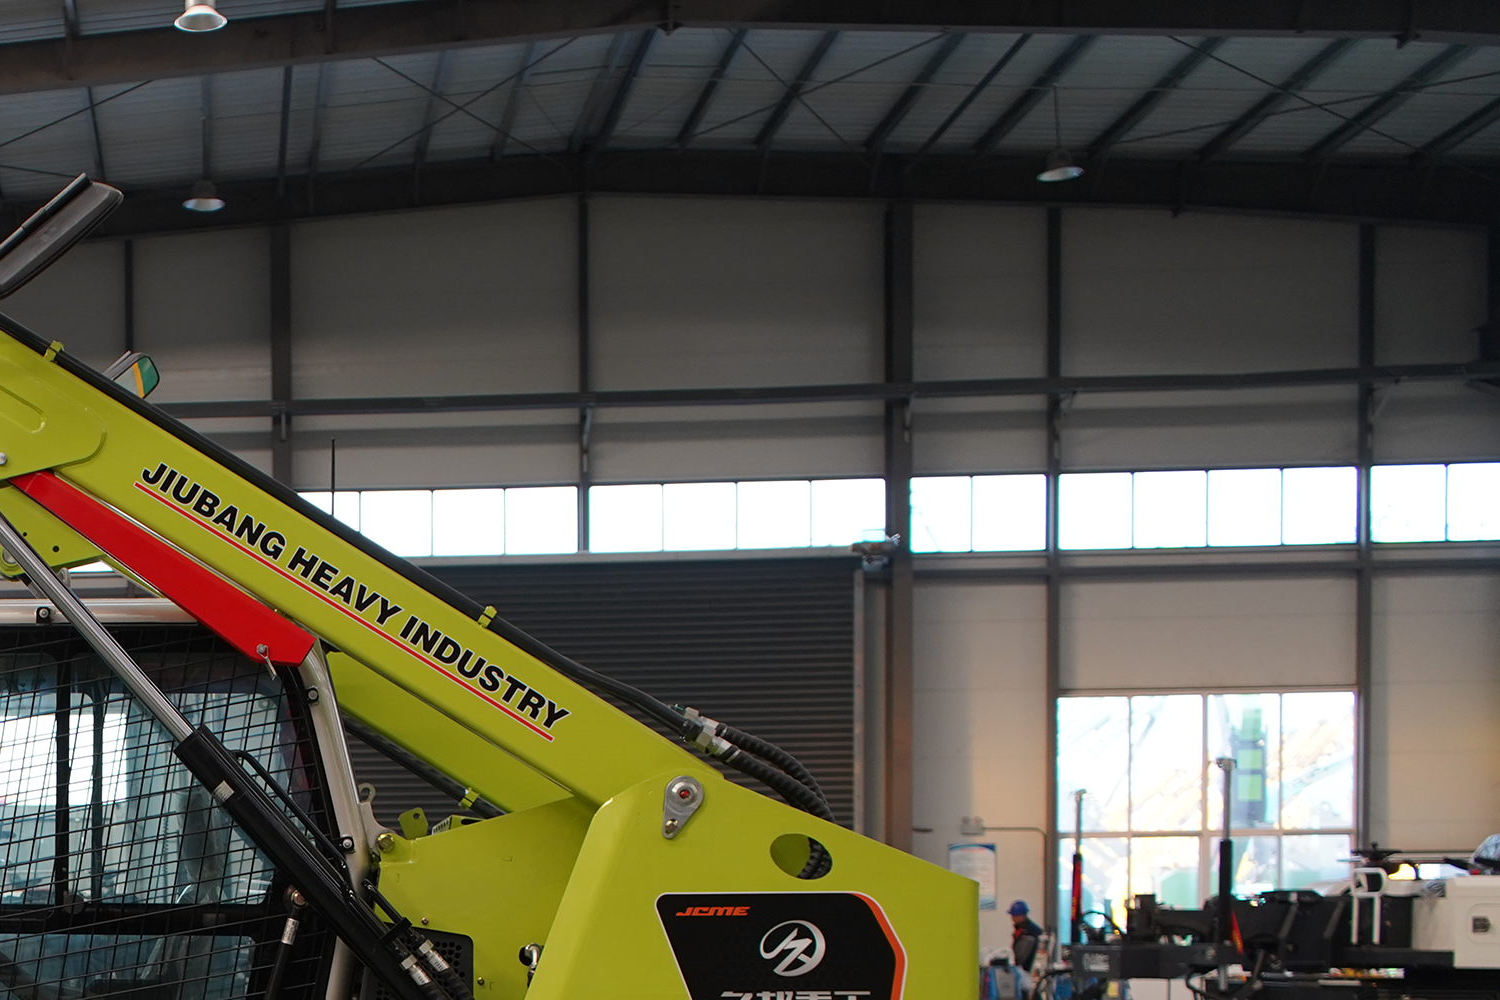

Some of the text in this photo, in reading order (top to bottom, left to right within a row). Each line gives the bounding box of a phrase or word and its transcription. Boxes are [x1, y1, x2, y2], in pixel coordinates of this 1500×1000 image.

[142, 462, 572, 730] JIUBANG HEAVY INDUSTRY
[675, 906, 751, 916] JCME
